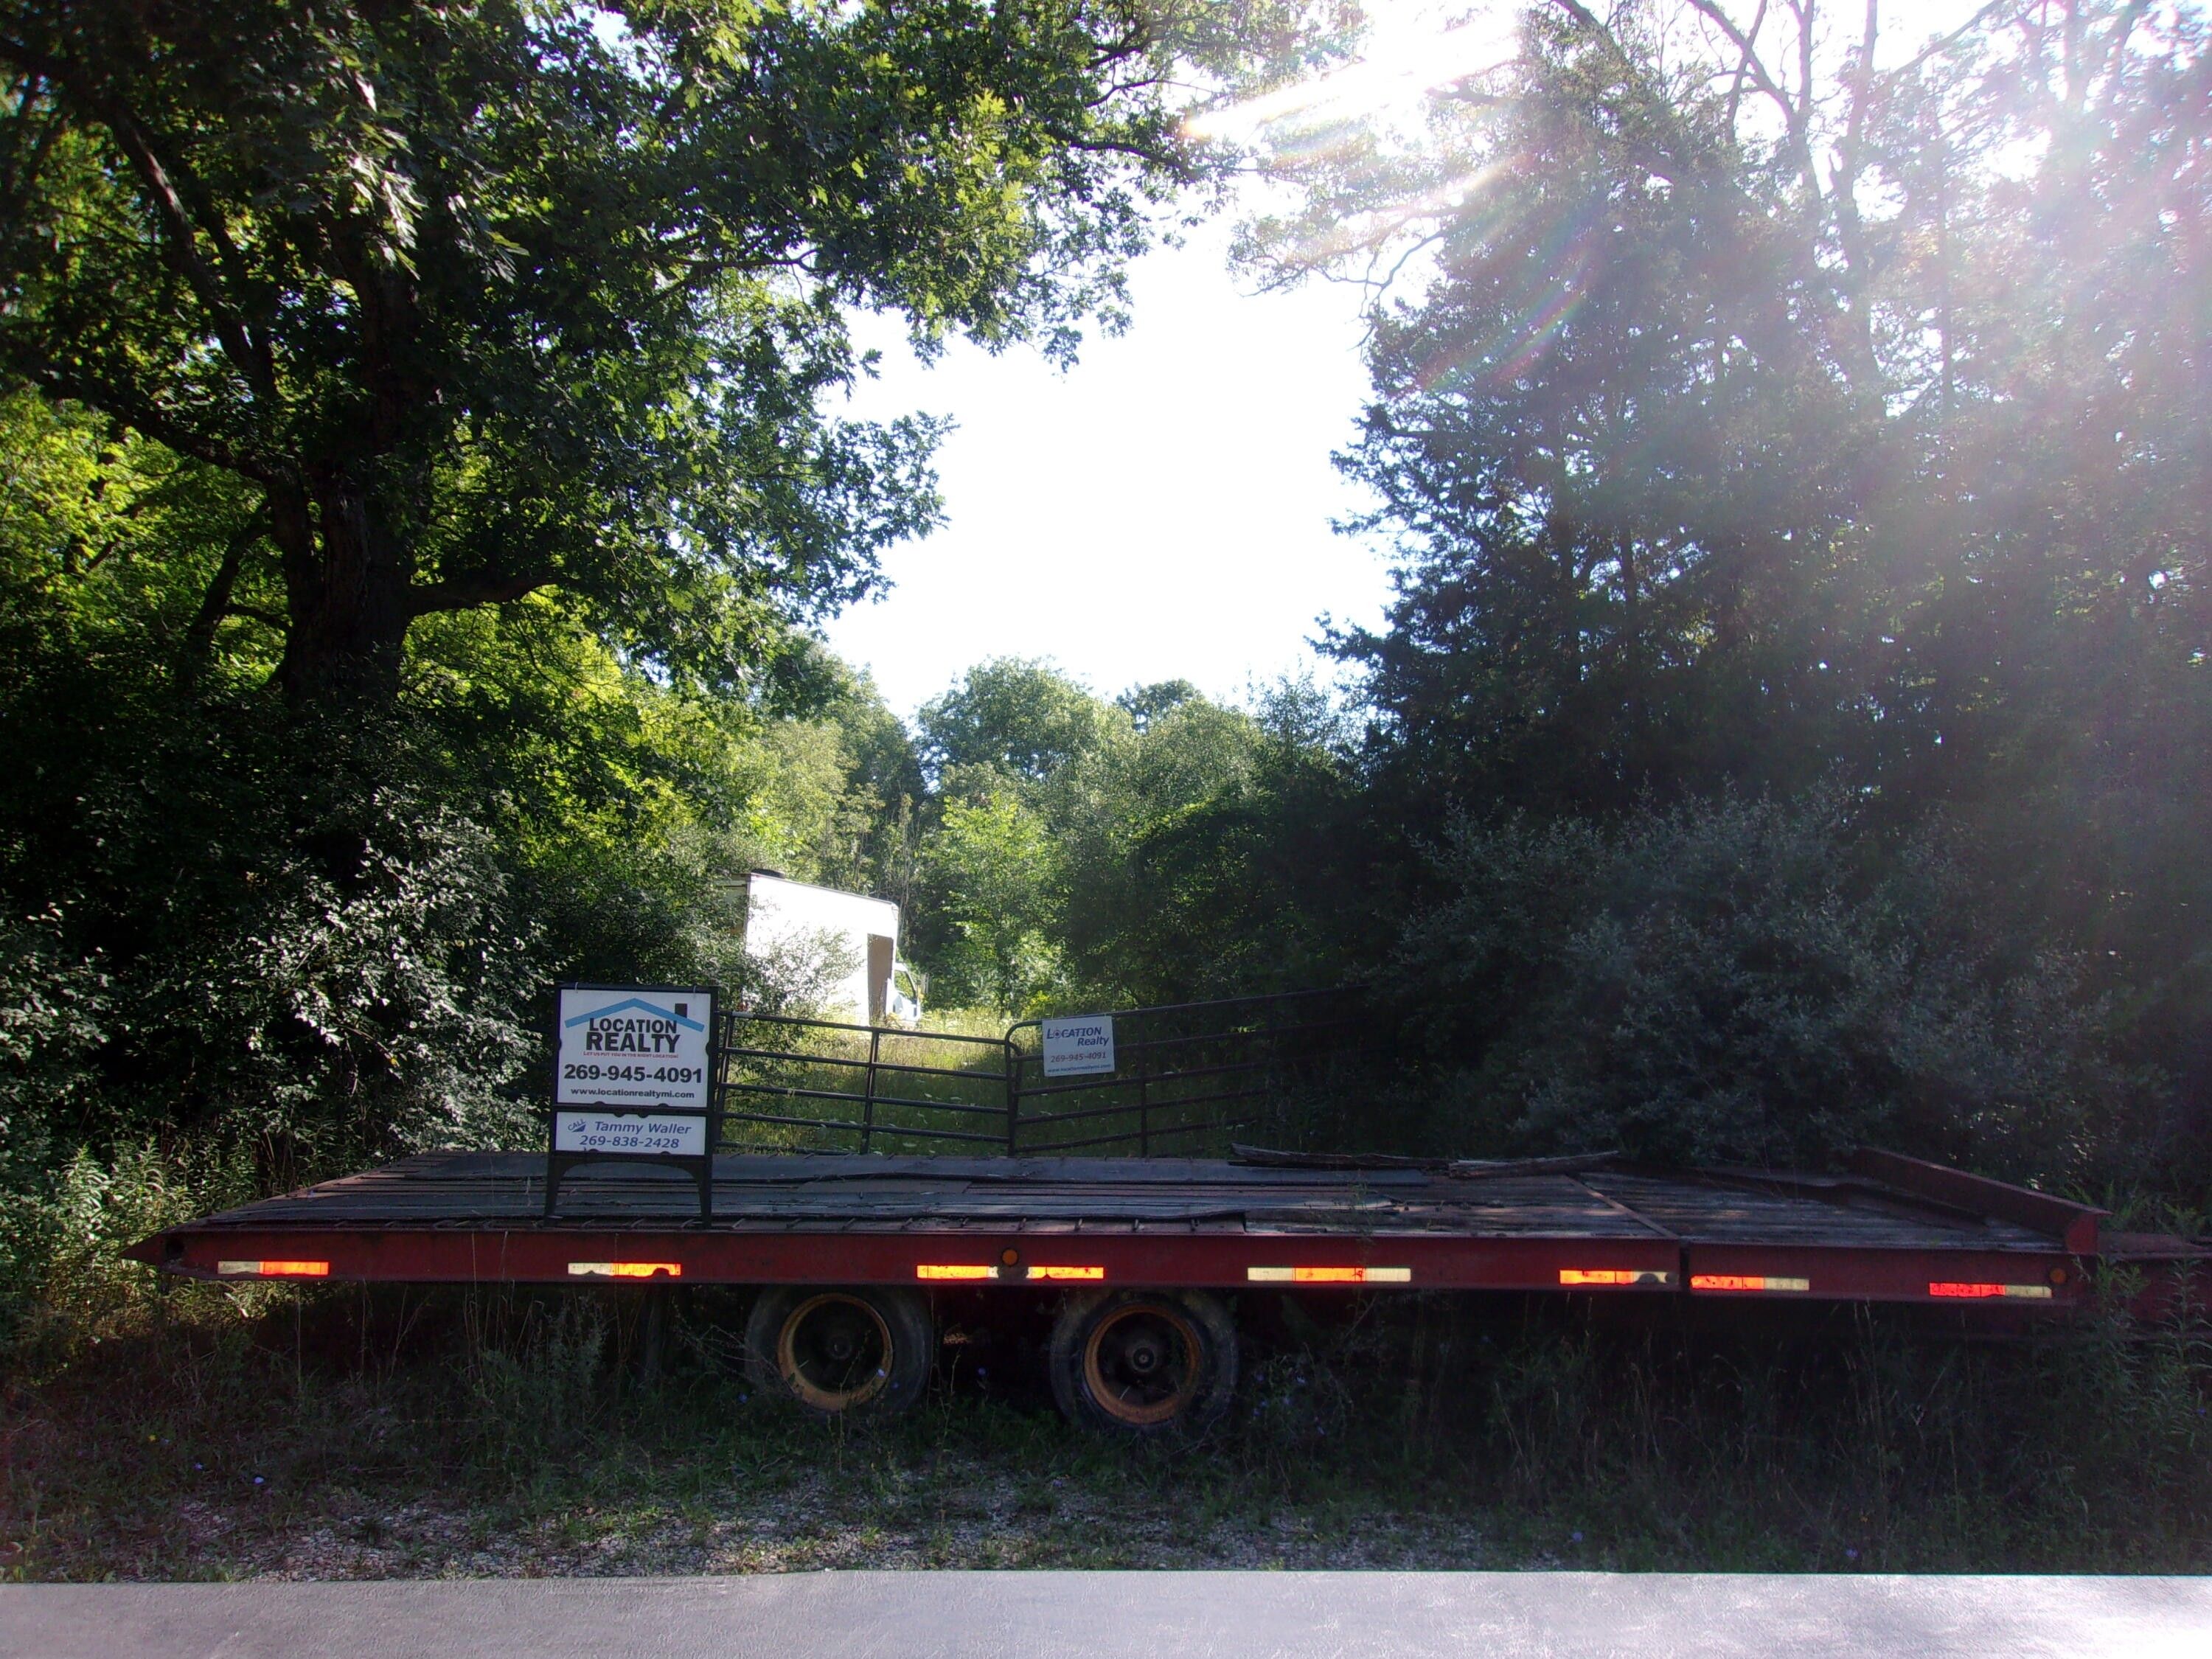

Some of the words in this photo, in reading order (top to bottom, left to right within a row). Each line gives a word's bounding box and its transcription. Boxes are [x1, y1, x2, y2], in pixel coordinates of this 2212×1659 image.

[590, 1018, 677, 1033] LOCATION
[585, 1032, 681, 1053] REALTY
[1077, 1036, 1110, 1046] Realty
[1051, 1051, 1106, 1062] 269-945-4091
[564, 1064, 702, 1083] 269-945-4091
[571, 1088, 695, 1099] www.locationrealtymi.com
[568, 1119, 585, 1131] CALL
[594, 1121, 644, 1135] Tammy
[648, 1123, 692, 1134] Waller
[580, 1135, 680, 1149] 269-838-2428
